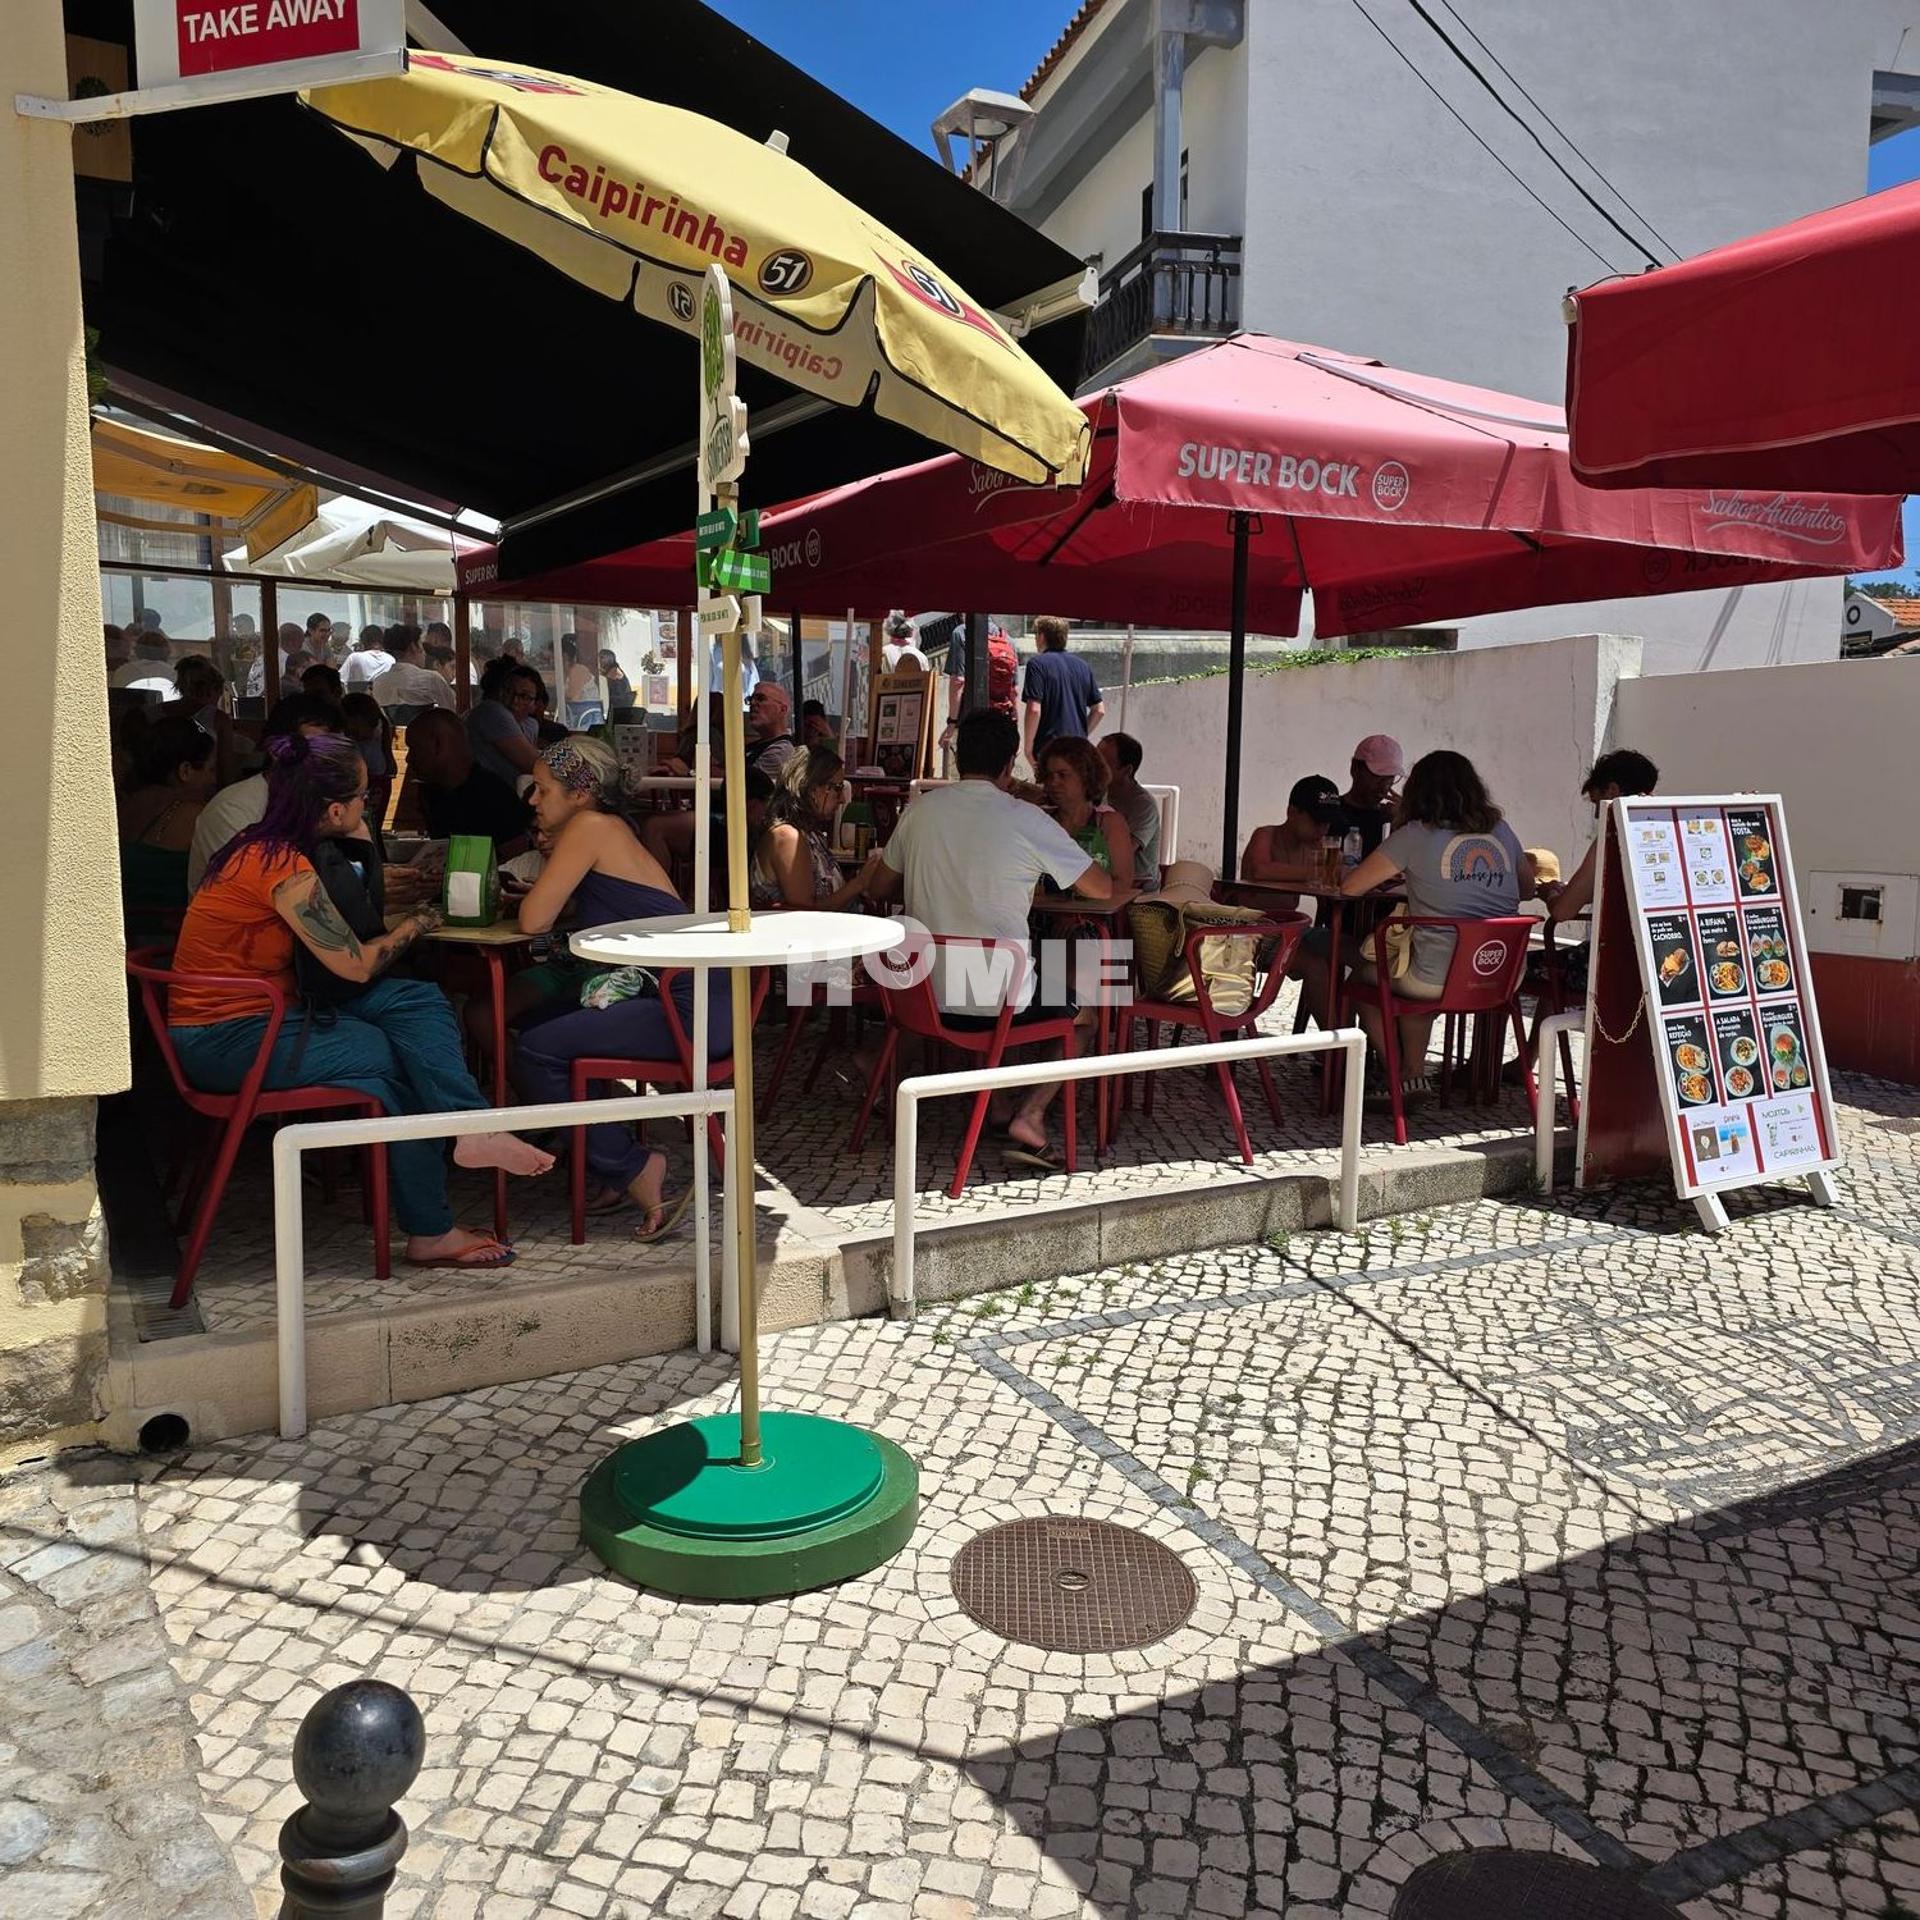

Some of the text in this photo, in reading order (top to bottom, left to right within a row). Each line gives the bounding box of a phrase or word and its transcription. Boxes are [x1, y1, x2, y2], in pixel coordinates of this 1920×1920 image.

[183, 0, 345, 43] TAKE AWAY
[538, 144, 806, 289] Caipirinha 51
[910, 266, 960, 313] 51
[1178, 443, 1361, 497] SUPER BOCK
[1376, 474, 1405, 487] SUPER
[1376, 485, 1404, 498] BOCK
[1701, 489, 1757, 519] Sabor
[771, 541, 802, 571] BOCK
[1454, 869, 1505, 887] choose joy
[1477, 957, 1500, 966] BOCK
[1479, 949, 1504, 958] SUPER
